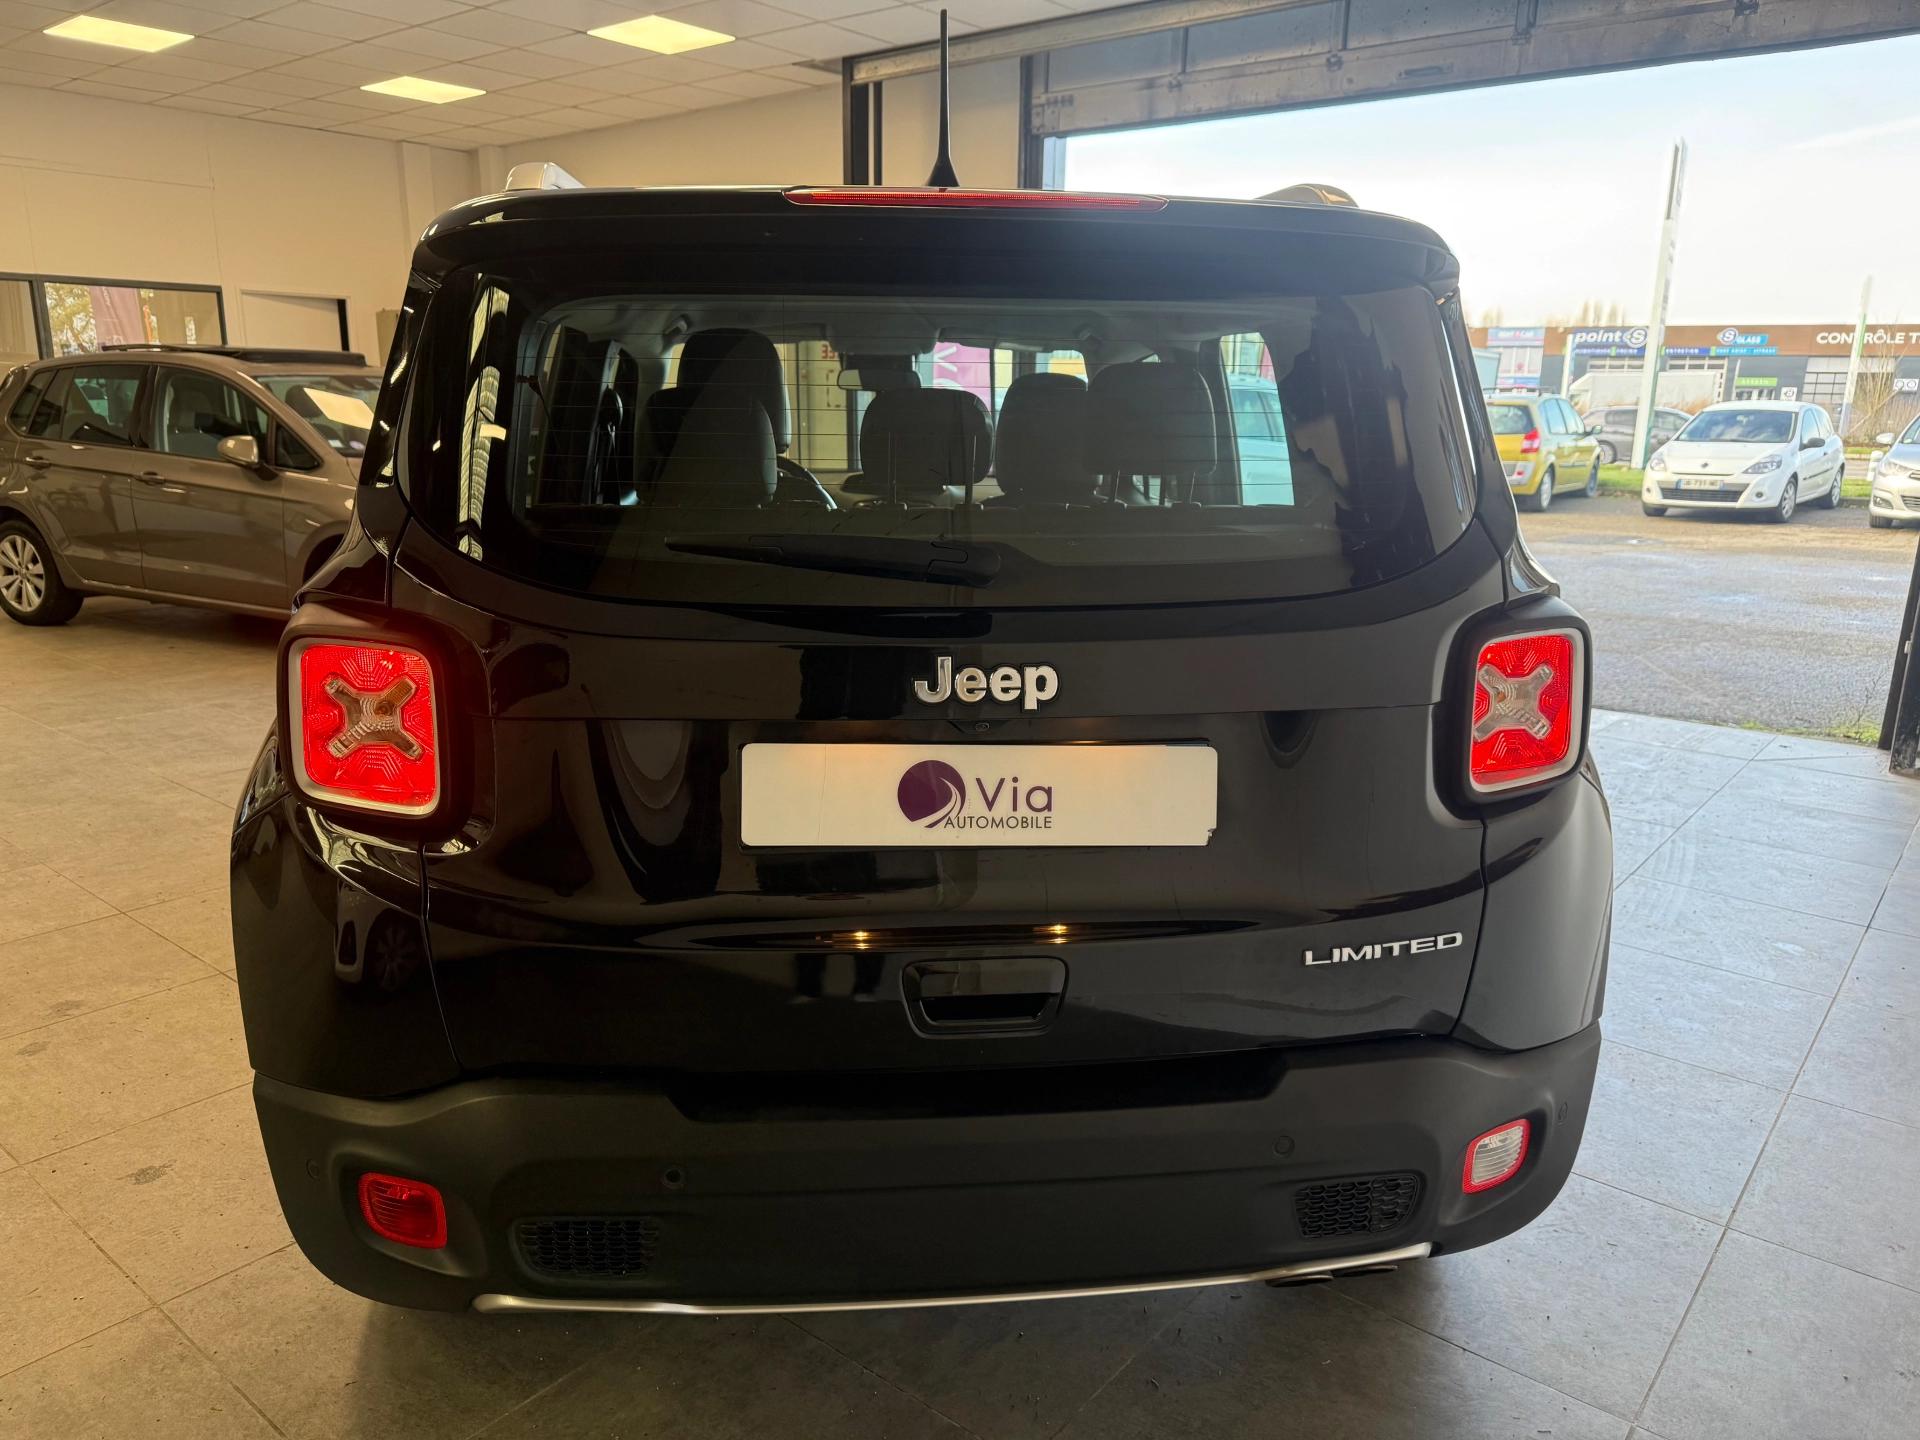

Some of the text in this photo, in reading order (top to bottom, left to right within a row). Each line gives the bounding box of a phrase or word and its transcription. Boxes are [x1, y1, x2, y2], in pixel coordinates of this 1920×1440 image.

[1575, 330, 1622, 344] point
[1816, 329, 1920, 345] CONRÔLE T
[914, 656, 1059, 710] Jeep
[976, 776, 1053, 813] Via
[943, 815, 1053, 829] AUTOMOBILE
[1304, 932, 1463, 966] LIMITED
